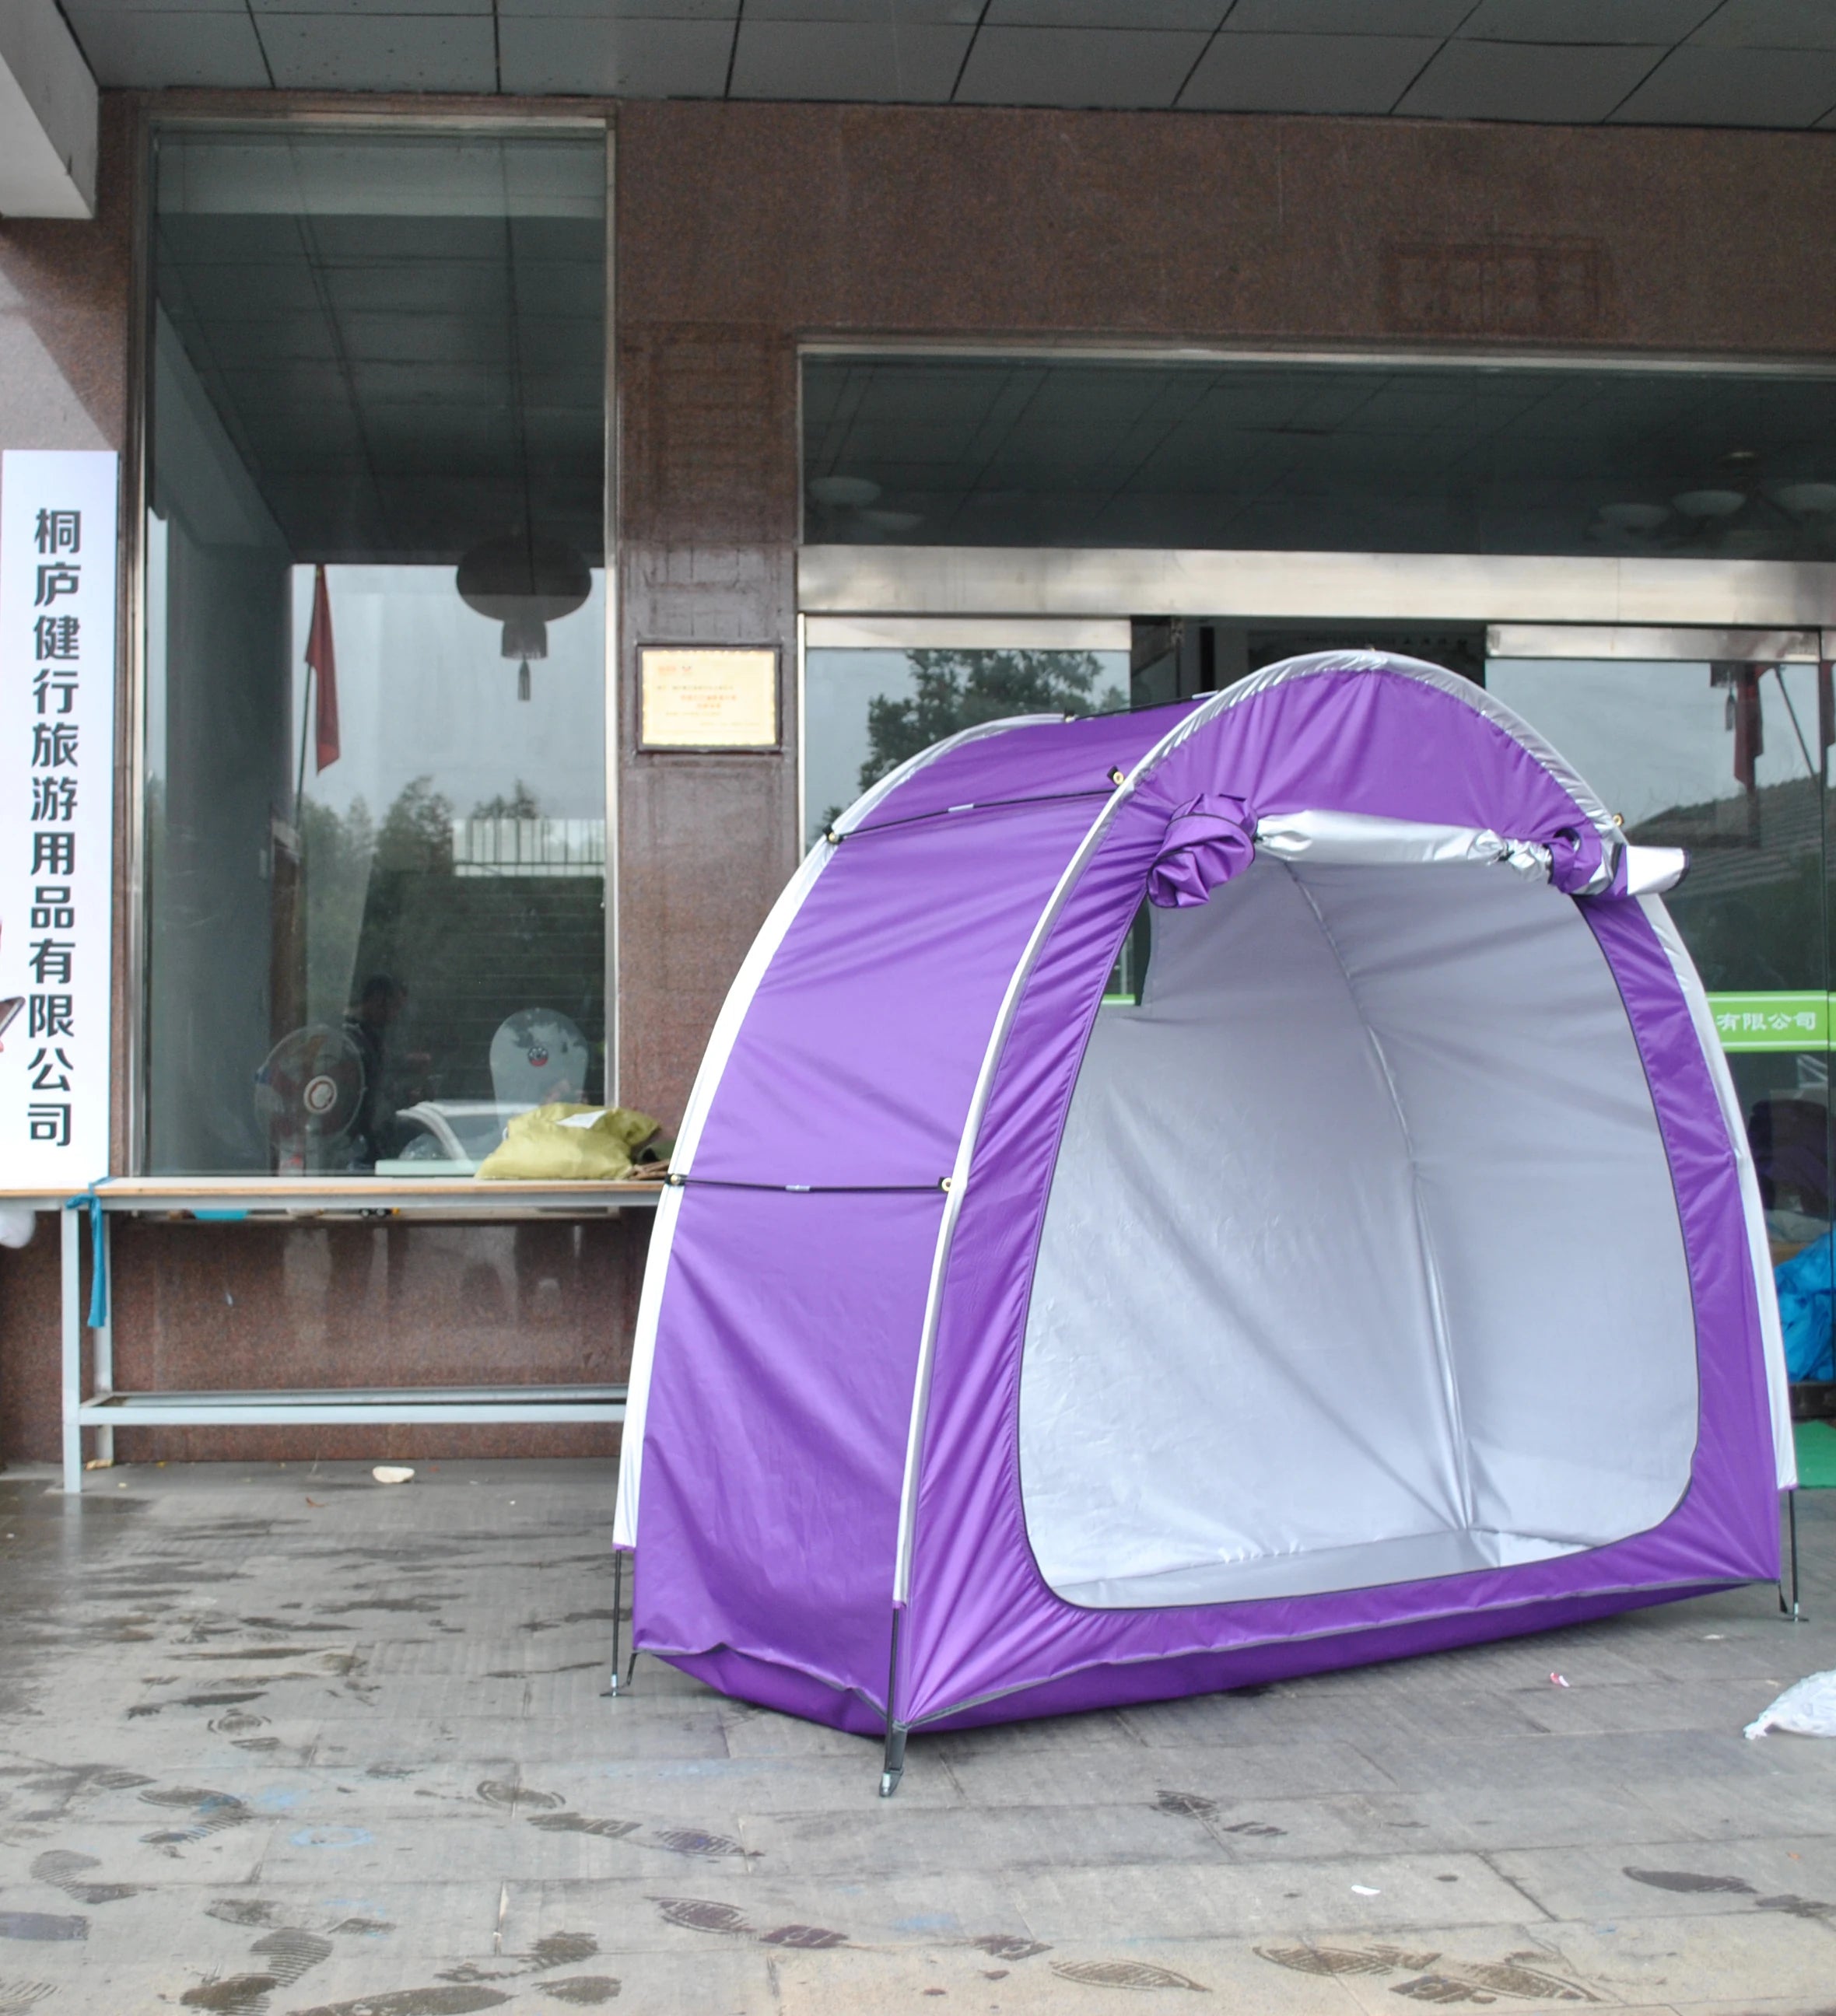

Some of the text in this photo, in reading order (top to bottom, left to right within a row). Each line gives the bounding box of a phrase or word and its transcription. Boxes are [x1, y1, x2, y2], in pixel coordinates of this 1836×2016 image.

[27, 508, 82, 1146] 桐庐健行旅游用品有限公司
[1717, 1012, 1817, 1031] 有限公司
